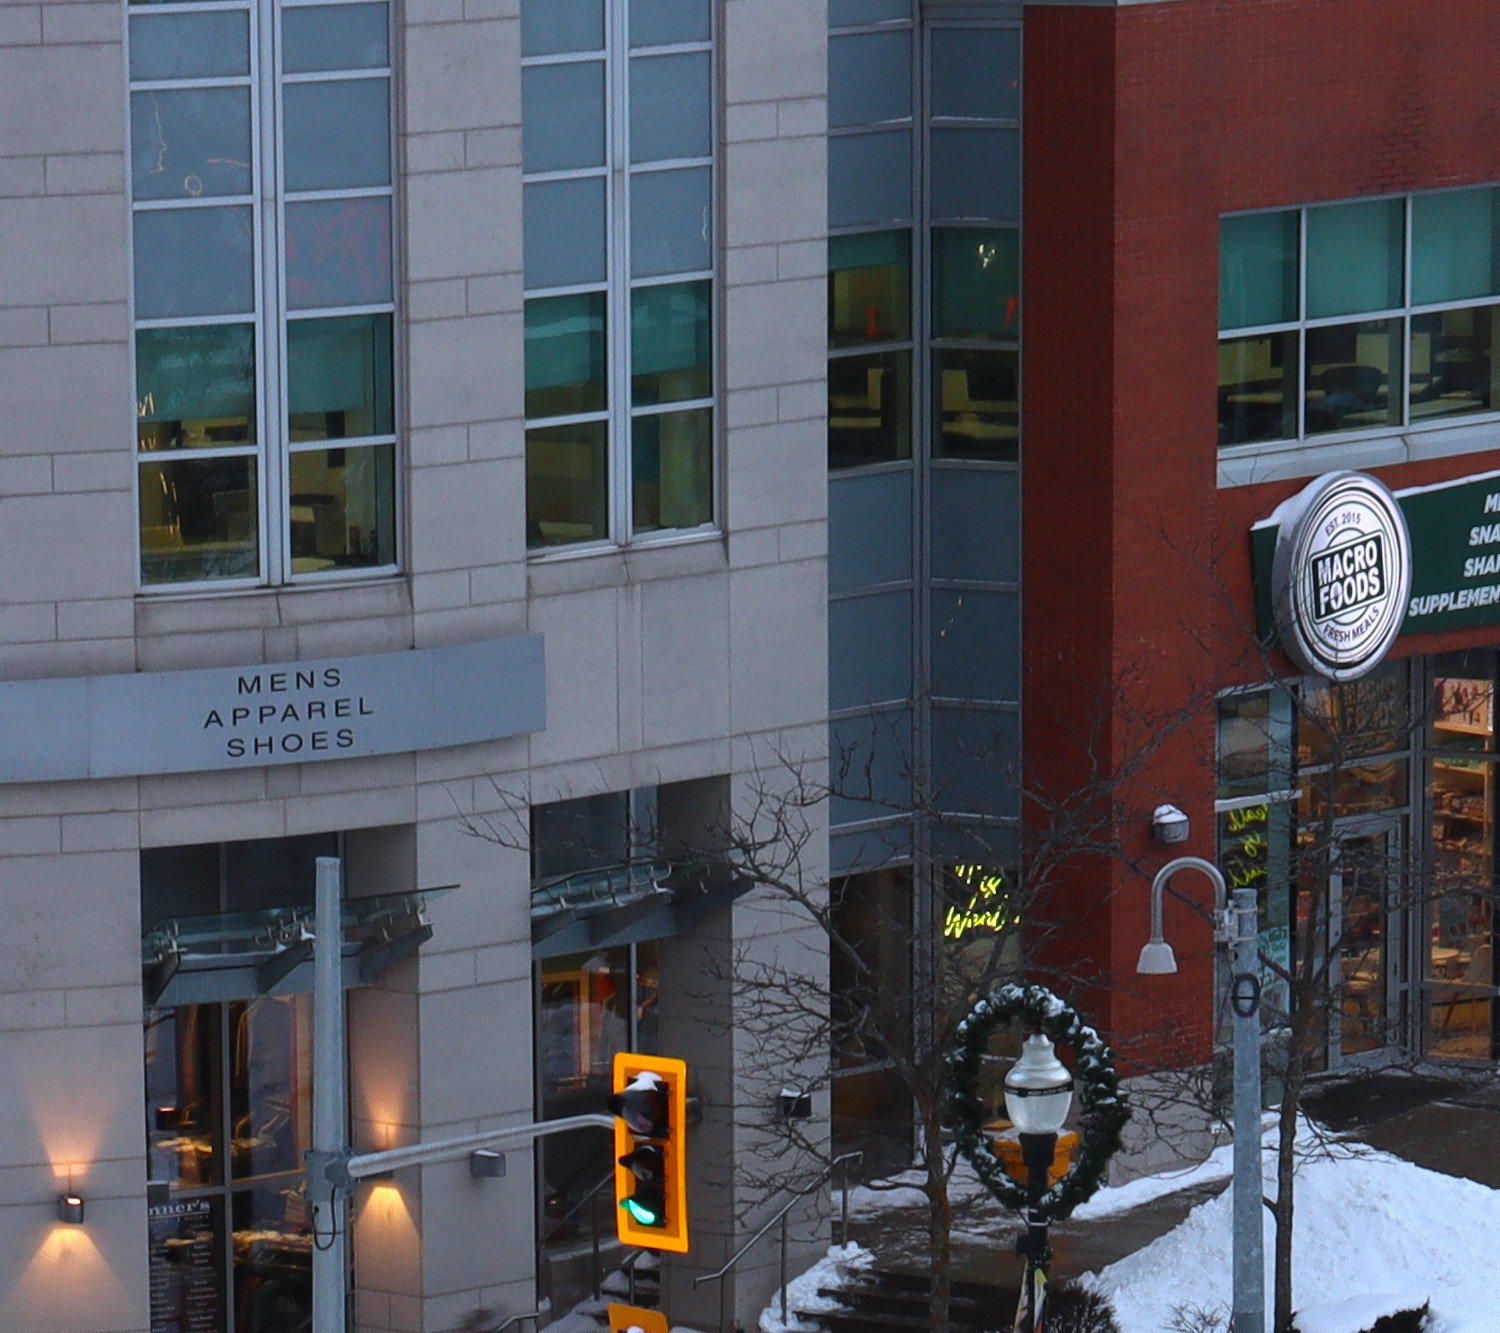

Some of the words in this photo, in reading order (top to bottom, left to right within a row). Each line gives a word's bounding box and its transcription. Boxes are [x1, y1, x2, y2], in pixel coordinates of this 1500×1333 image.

[1342, 511, 1361, 525] 2015
[1317, 540, 1377, 586] MACRO
[1319, 567, 1381, 616] FOODS
[1323, 623, 1350, 643] FRESH
[1350, 607, 1380, 640] MEALS
[238, 668, 341, 695] MENS
[204, 697, 373, 728] APPAREL
[227, 729, 353, 758] SHOES
